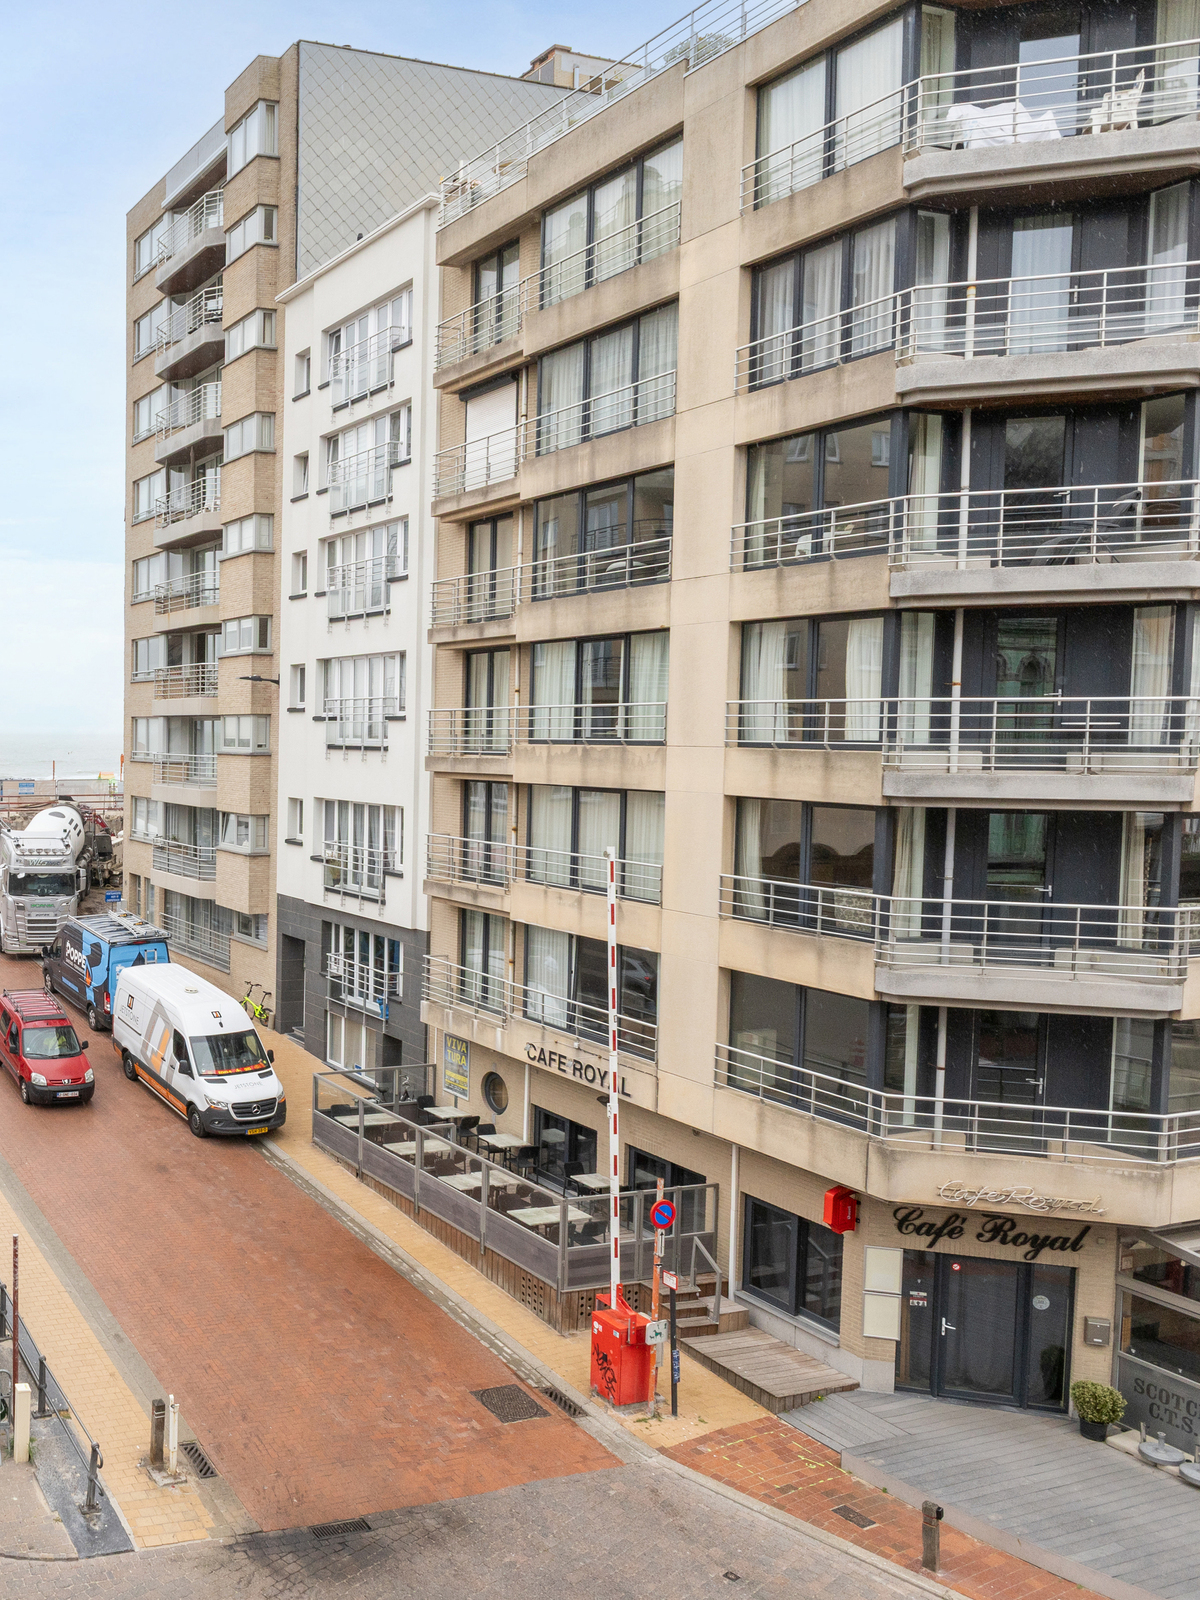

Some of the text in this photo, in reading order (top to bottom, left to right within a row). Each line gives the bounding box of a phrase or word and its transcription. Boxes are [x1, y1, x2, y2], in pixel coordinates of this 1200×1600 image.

[65, 941, 87, 969] POPPE
[446, 1036, 467, 1053] VIVA
[446, 1049, 467, 1067] TURA
[526, 1043, 631, 1098] CAFE ROYL
[234, 1081, 264, 1090] JETSTONE
[1002, 1186, 1108, 1214] Royal
[893, 1206, 1091, 1260] Café Royal
[1133, 1377, 1200, 1419] SCOTC
[1149, 1402, 1199, 1437] C.T.S.
